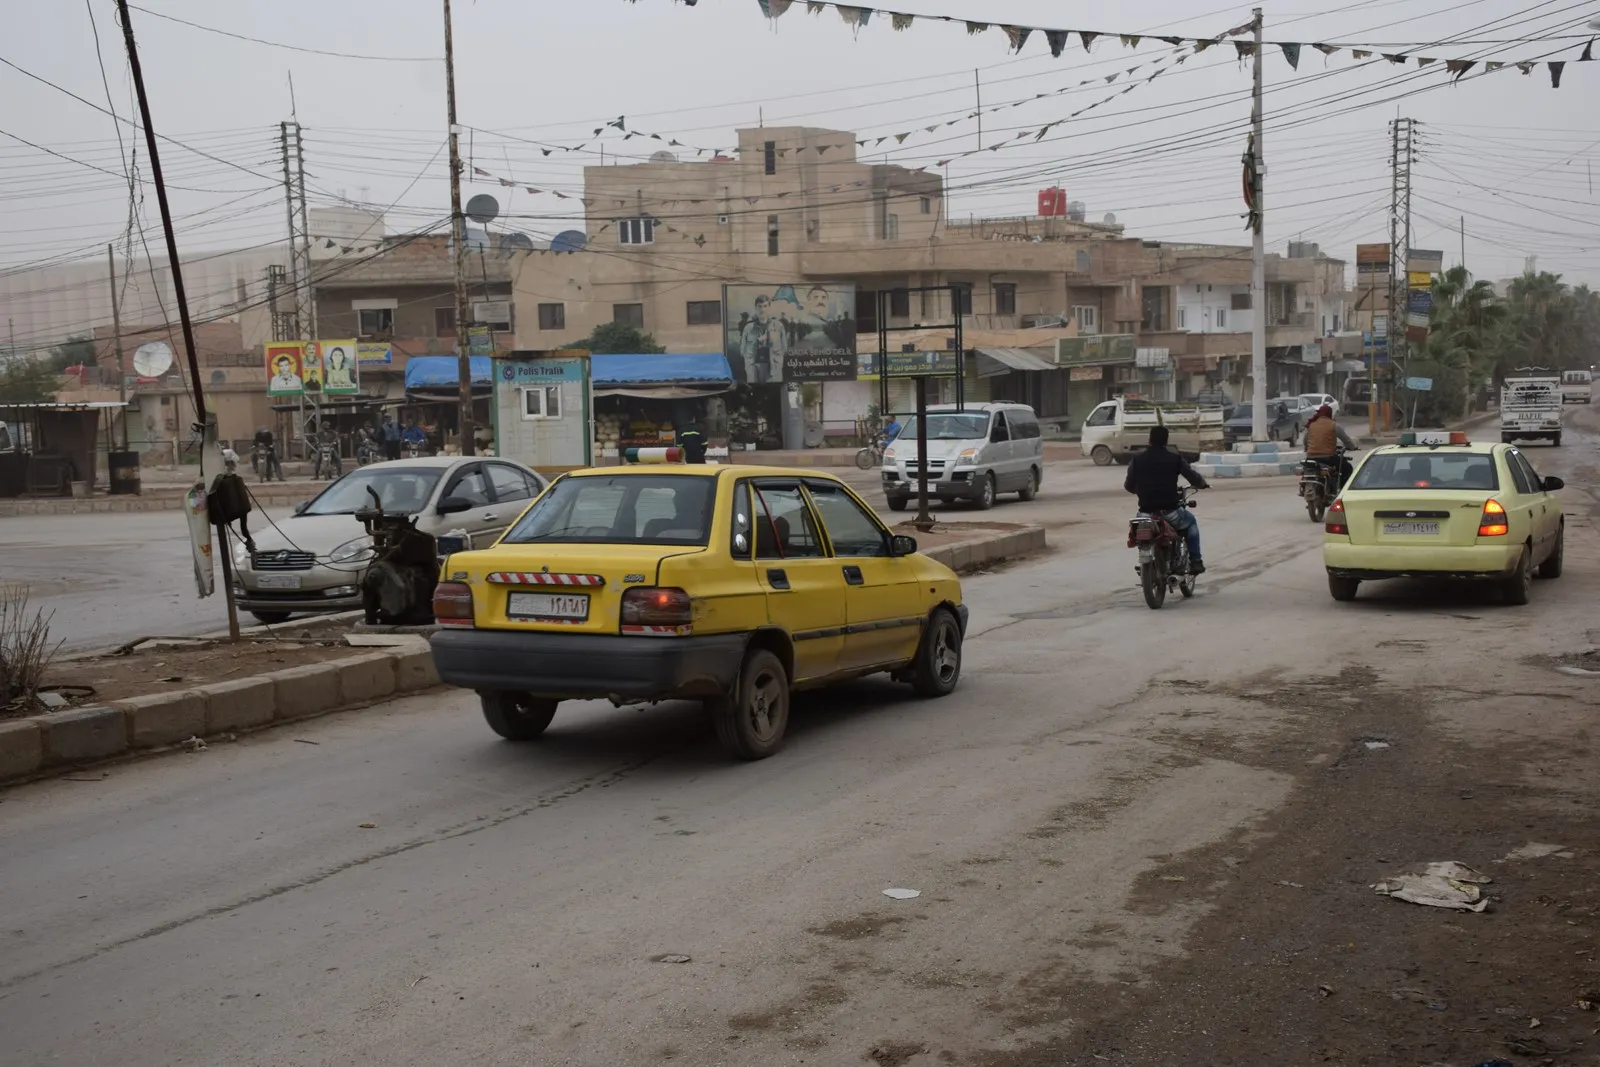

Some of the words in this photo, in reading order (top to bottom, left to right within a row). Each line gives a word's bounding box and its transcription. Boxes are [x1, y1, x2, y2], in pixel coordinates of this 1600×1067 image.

[803, 357, 828, 368] الشهيد
[828, 357, 851, 366] ساحة
[518, 367, 539, 376] Polis
[540, 366, 564, 375] Trafik
